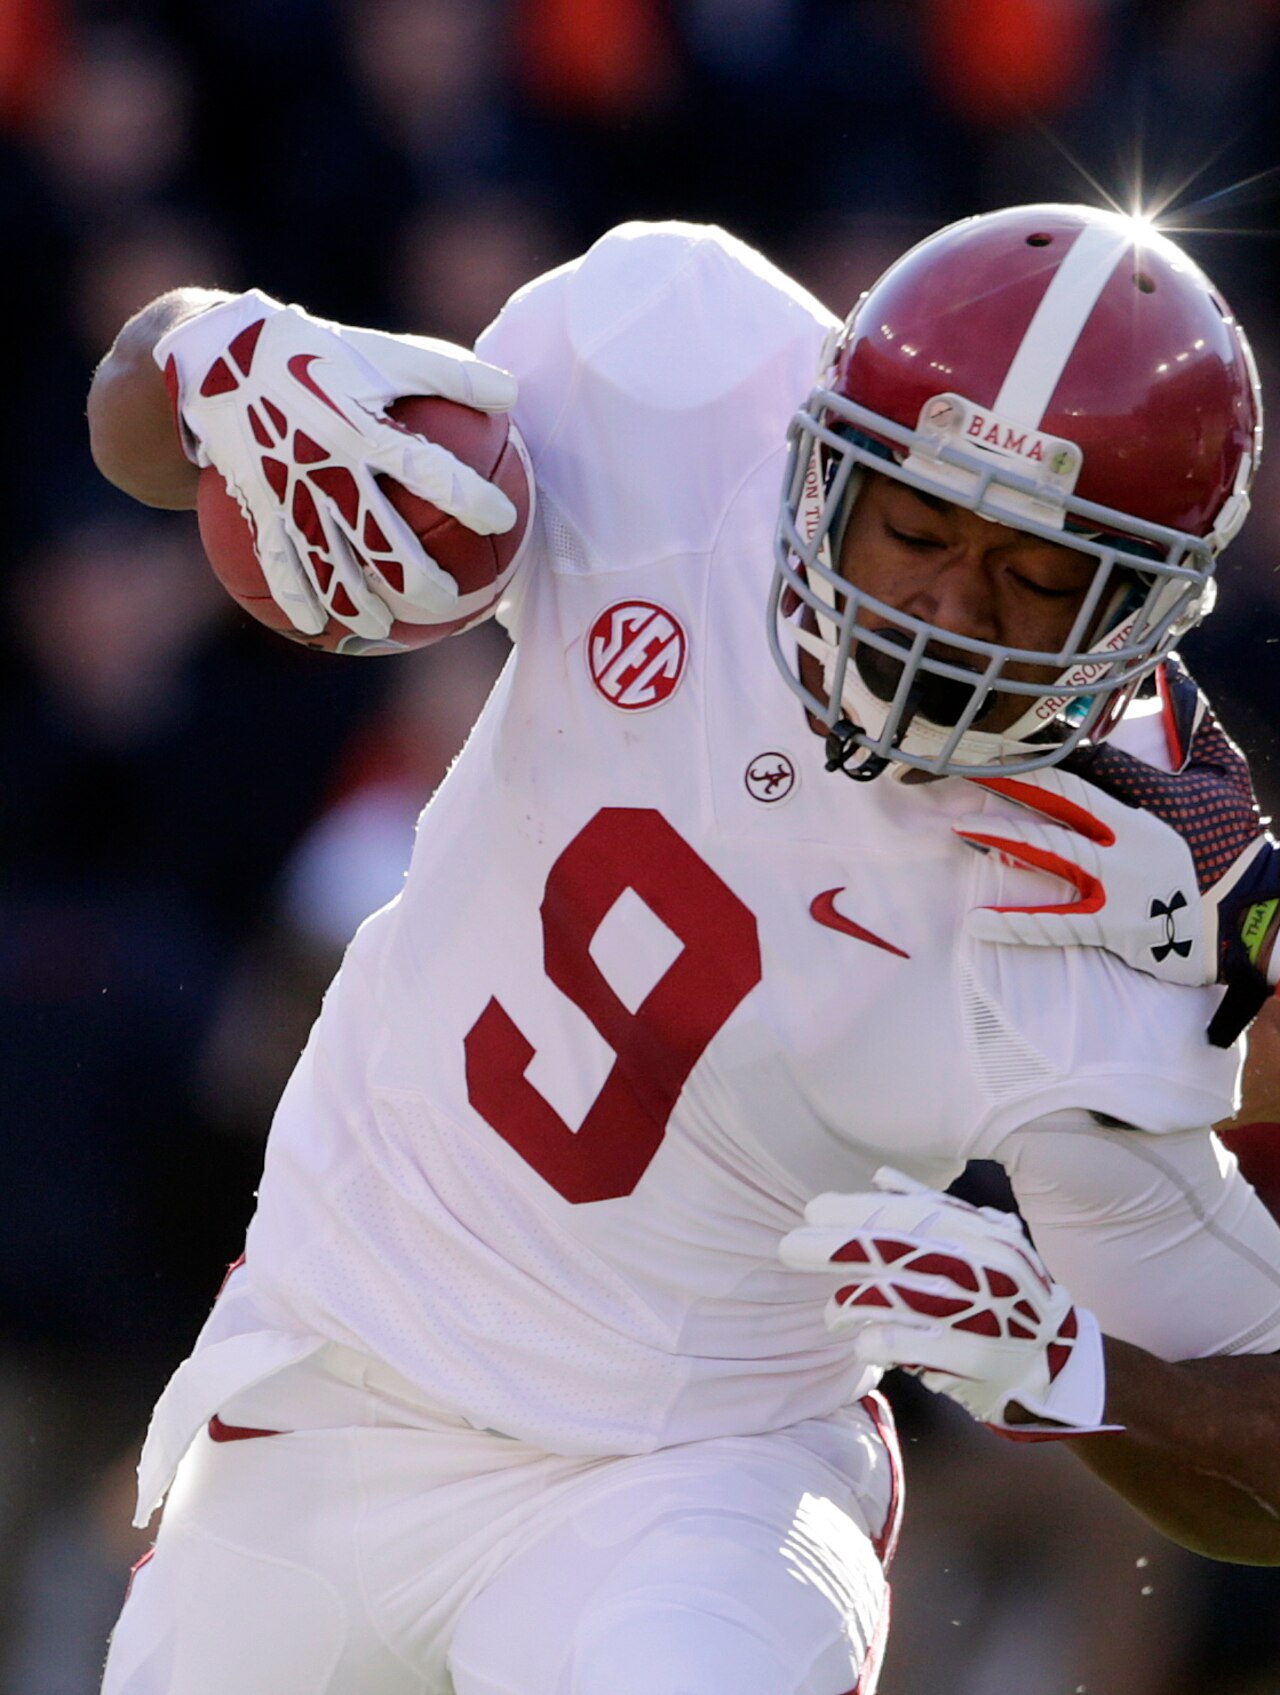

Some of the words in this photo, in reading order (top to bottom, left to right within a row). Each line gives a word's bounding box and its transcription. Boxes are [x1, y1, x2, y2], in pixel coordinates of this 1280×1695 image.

[967, 415, 1045, 462] BAMA
[593, 605, 681, 704] SEC
[1036, 661, 1108, 719] CRISO
[464, 807, 762, 1204] 9
